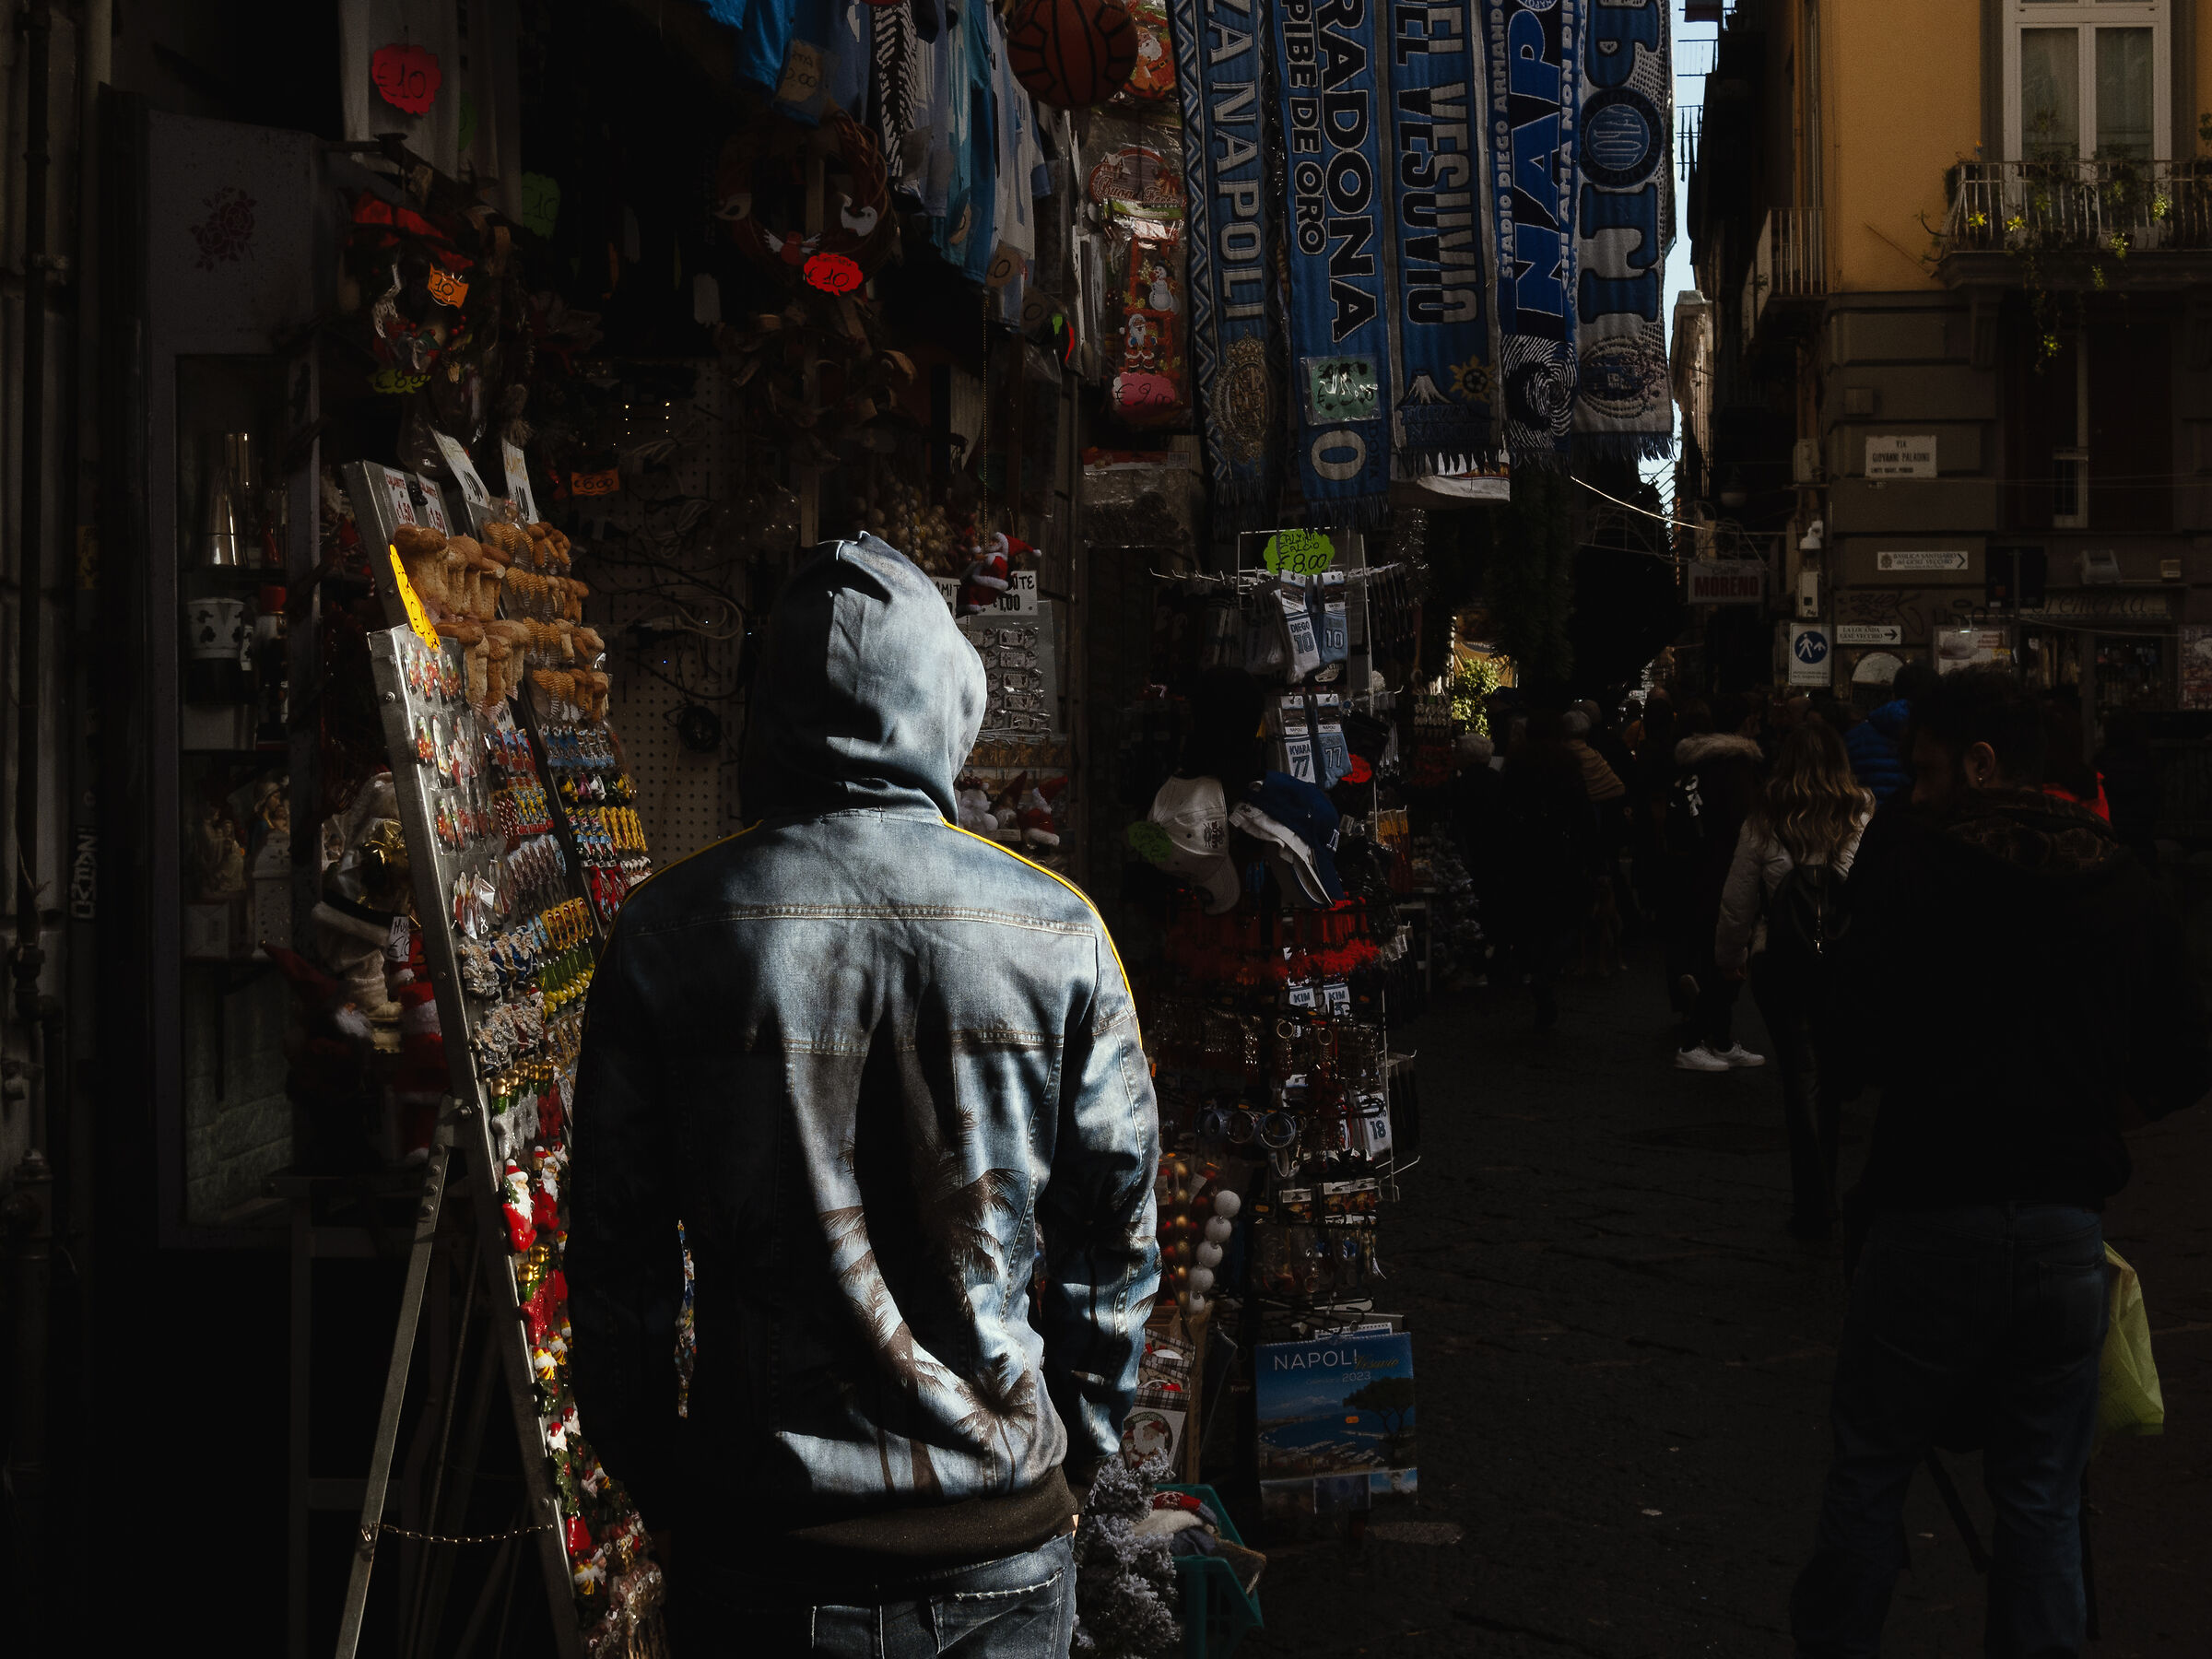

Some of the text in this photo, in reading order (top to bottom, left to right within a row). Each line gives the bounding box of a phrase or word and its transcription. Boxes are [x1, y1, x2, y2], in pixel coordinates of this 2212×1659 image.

[1561, 59, 1573, 131] NON
[1280, 0, 1327, 255] PIBE DE ORO
[1495, 120, 1512, 187] DIEGO
[1212, 81, 1265, 319] NAPOLI
[1397, 81, 1478, 325] VESUVIO
[1499, 194, 1513, 278] STADIO
[1694, 576, 1759, 597] MORENO
[1290, 621, 1310, 633] DIEGO
[1294, 632, 1315, 653] 10
[1325, 629, 1345, 650] 10
[1288, 743, 1311, 756] KVARA
[1324, 747, 1343, 769] 77
[1293, 755, 1310, 778] 77
[1293, 992, 1311, 1004] KIM
[1328, 990, 1346, 1002] KIM
[1370, 1119, 1386, 1140] 18
[1274, 1348, 1358, 1371] NAPOLI
[1341, 1371, 1371, 1383] 2023
